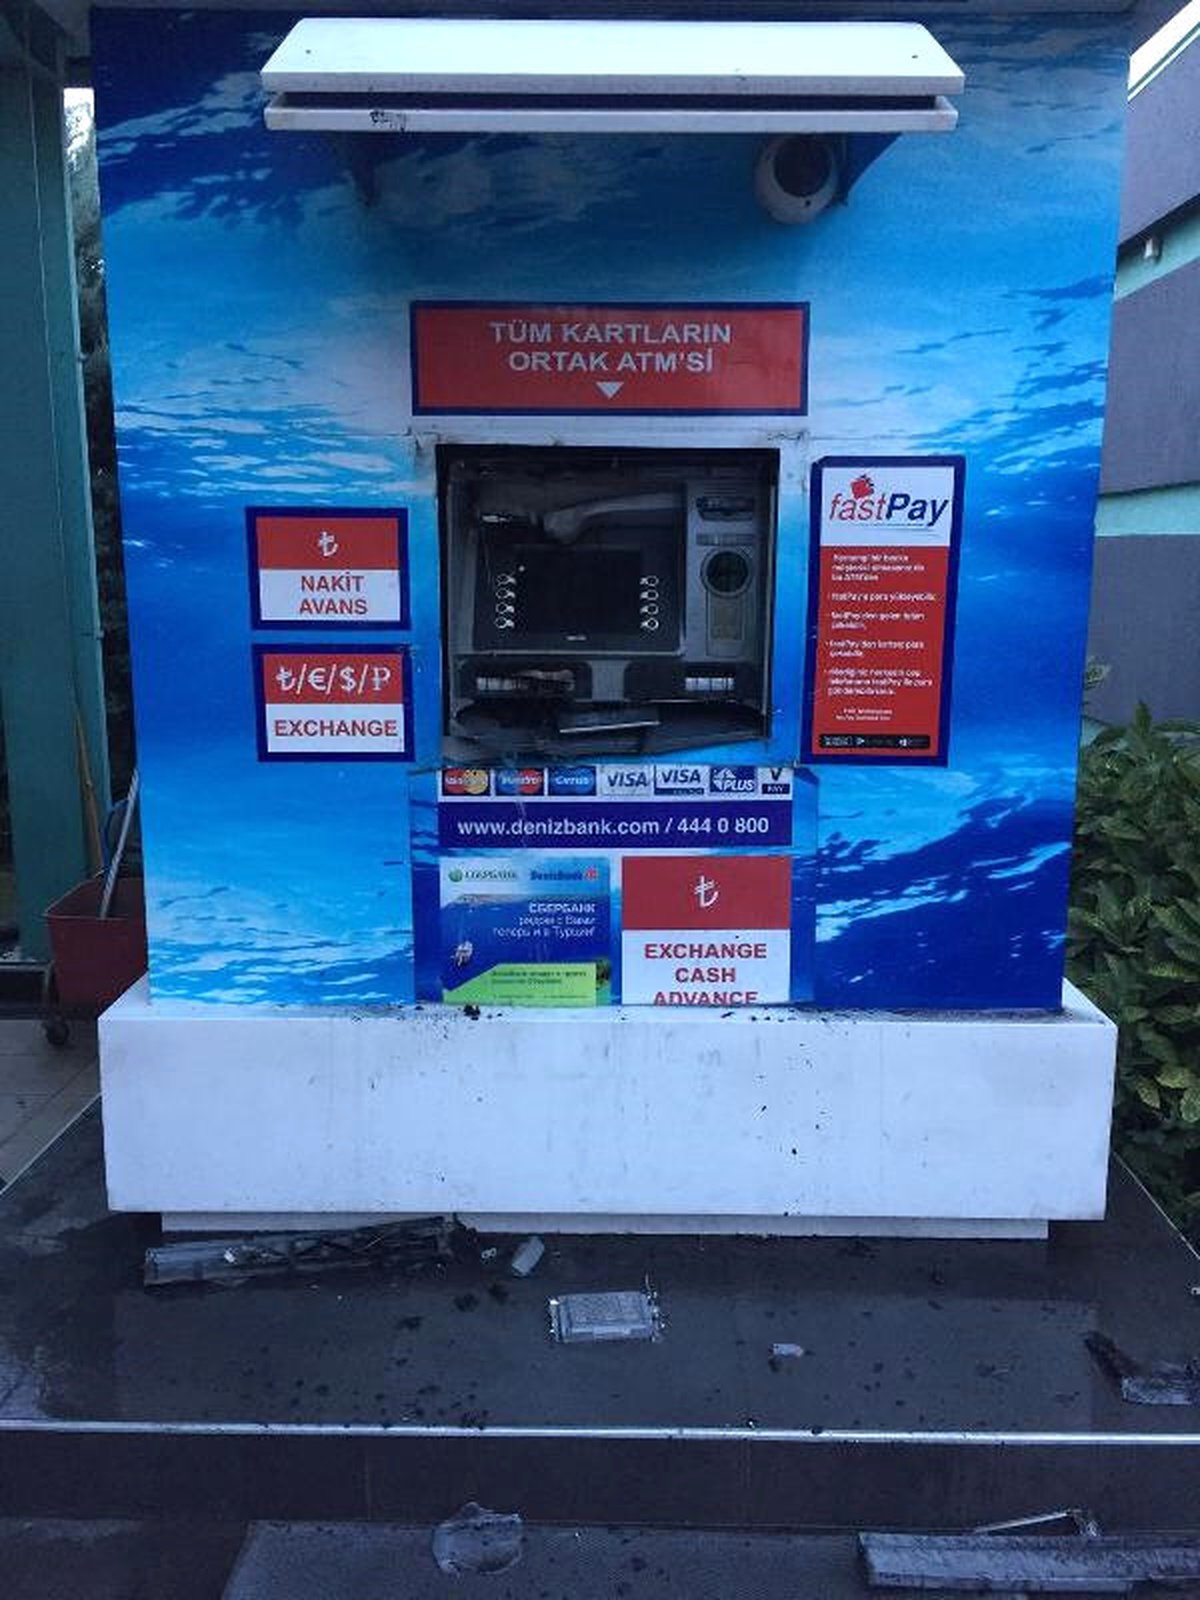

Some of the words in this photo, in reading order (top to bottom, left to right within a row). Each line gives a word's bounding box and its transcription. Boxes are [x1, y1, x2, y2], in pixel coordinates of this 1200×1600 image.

[490, 320, 552, 344] TÜM
[561, 323, 731, 344] KARTLARIN
[508, 351, 608, 371] ORTAK
[616, 349, 713, 373] ATM'Sİ
[829, 492, 949, 527] fastPay
[301, 572, 364, 593] NAKİT
[300, 599, 368, 615] AVANS
[274, 720, 398, 737] EXCHANGE
[607, 772, 648, 787] VISA
[661, 769, 701, 784] VISA
[723, 779, 755, 792] PLUS
[457, 818, 659, 835] www.denizbank.com
[677, 819, 711, 833] 444
[717, 818, 729, 833] 0
[735, 818, 769, 833] 800
[644, 943, 767, 959] EXCHANGE
[675, 967, 736, 983] CASH
[654, 991, 758, 1005] ADVANCE
